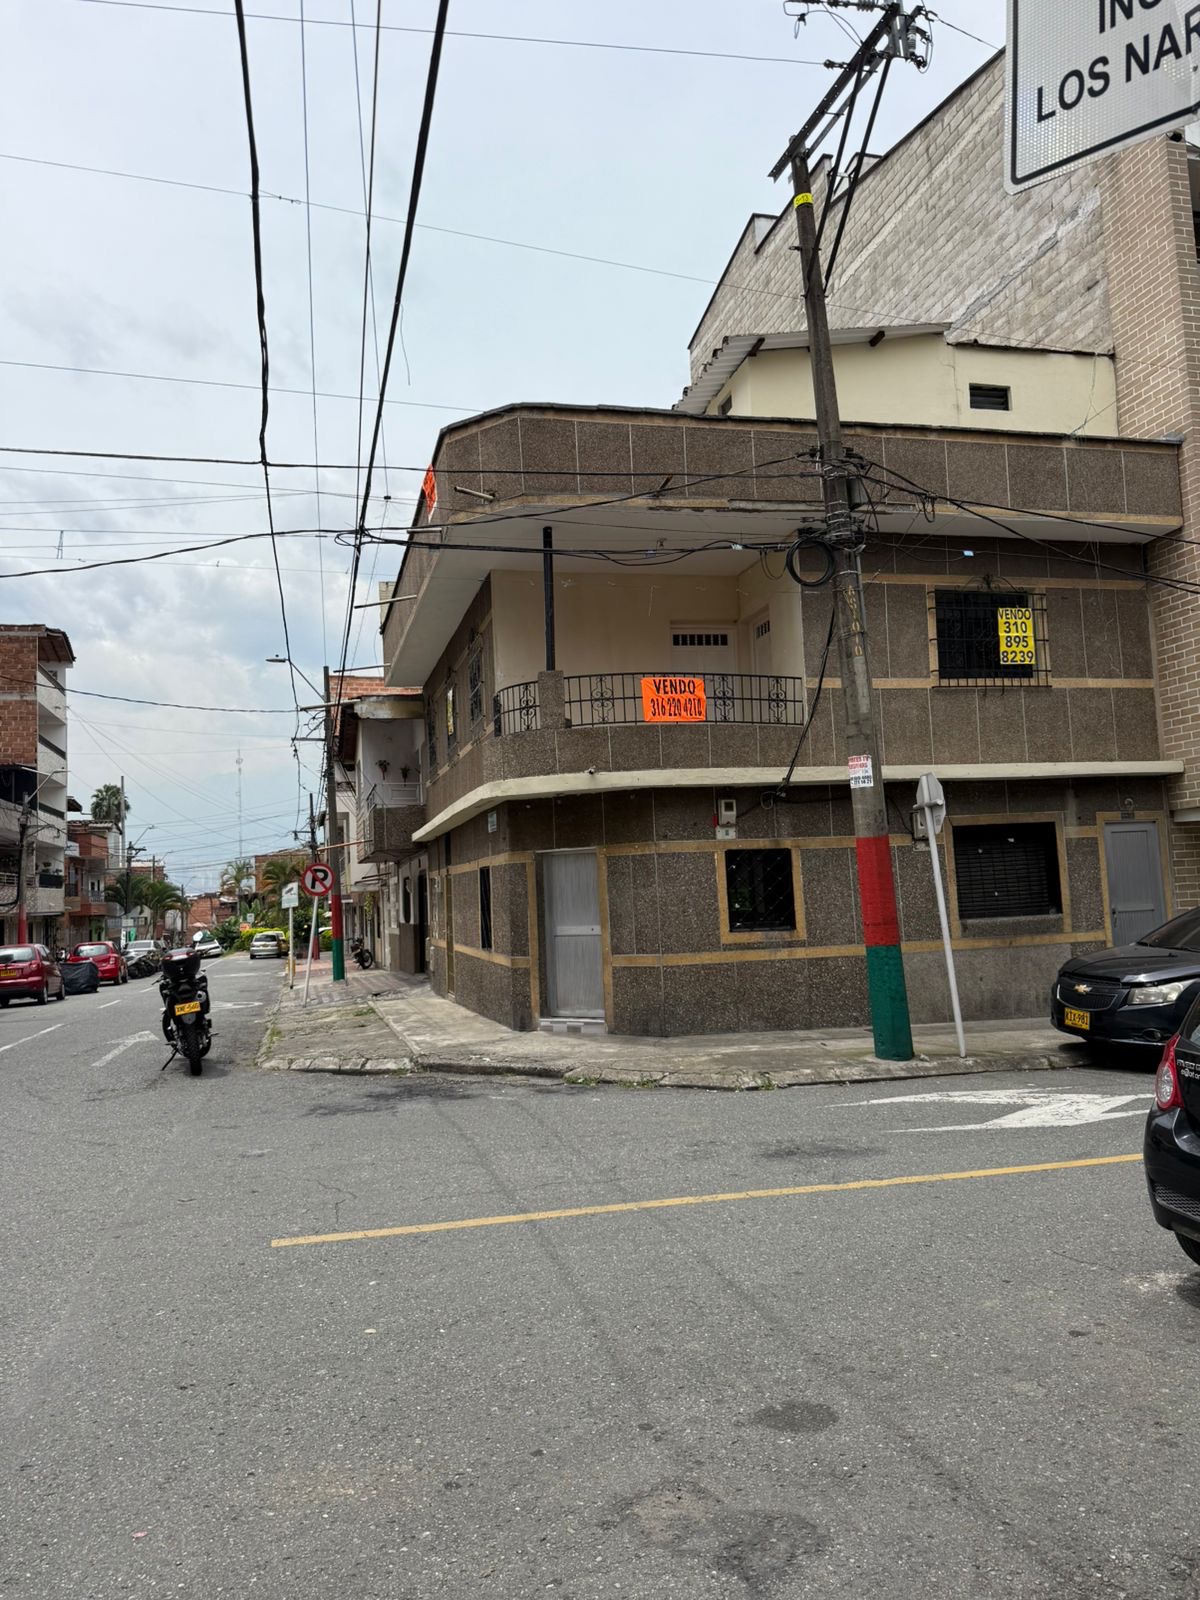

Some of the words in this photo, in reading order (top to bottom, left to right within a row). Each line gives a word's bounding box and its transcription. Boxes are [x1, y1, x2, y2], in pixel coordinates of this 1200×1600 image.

[1099, 0, 1163, 34] IN
[1037, 56, 1110, 123] LOS
[998, 609, 1031, 620] VENDO
[1004, 621, 1027, 633] 310
[1005, 635, 1029, 648] 895
[1002, 650, 1034, 663] 8239
[653, 679, 695, 694] VENDO
[651, 698, 666, 717] 316
